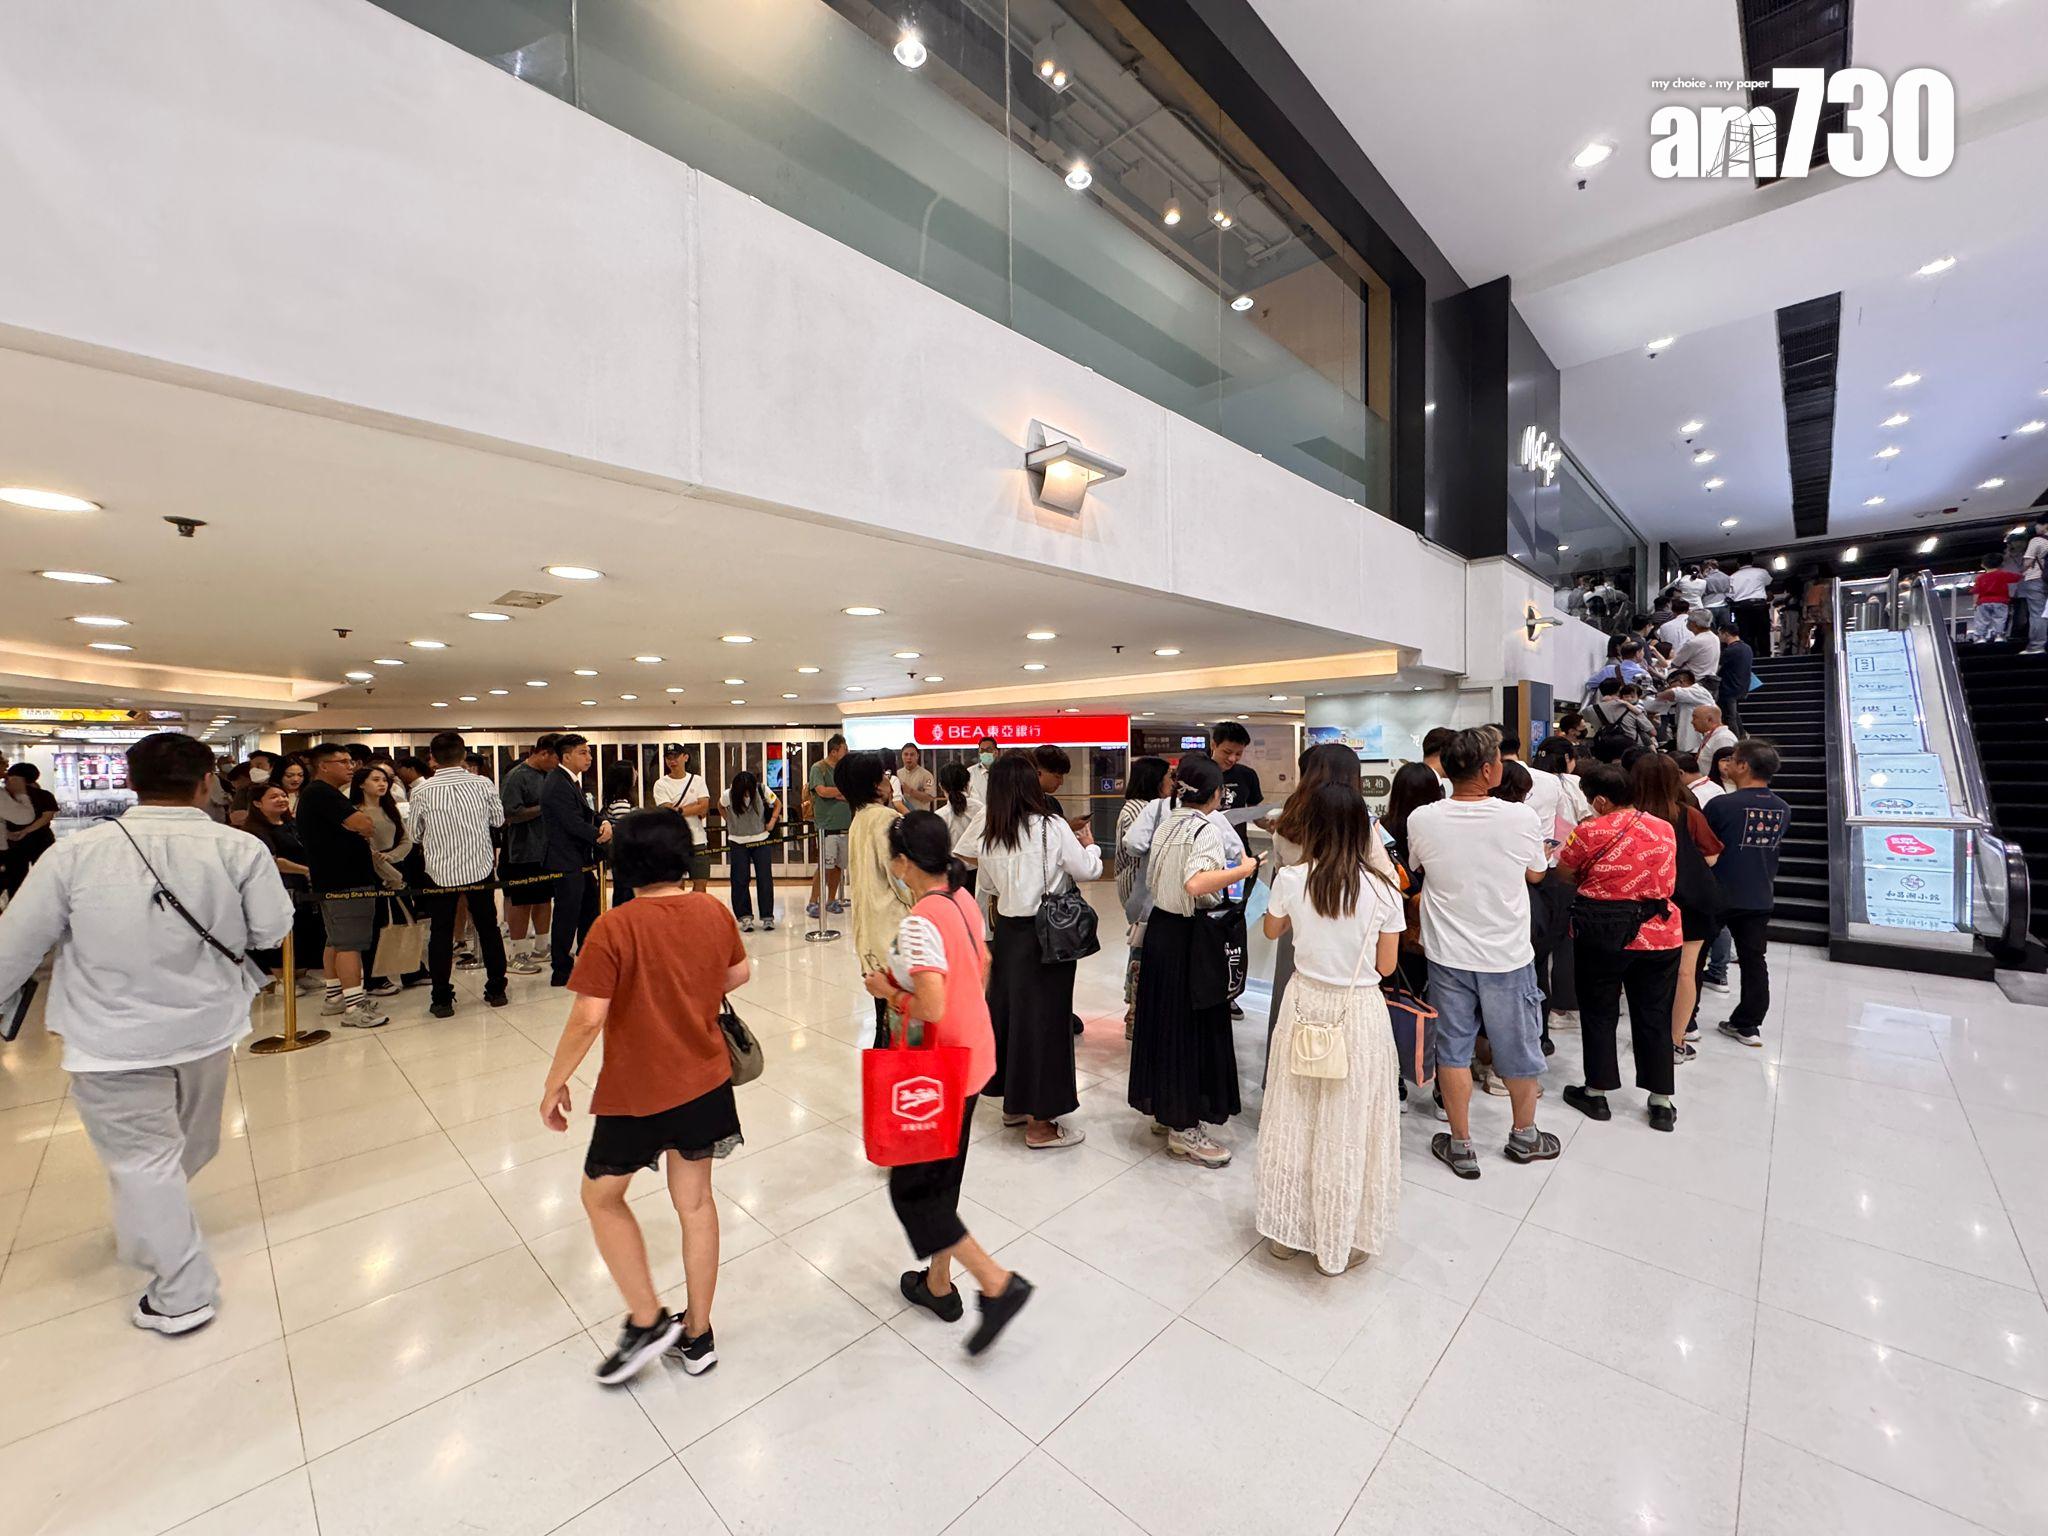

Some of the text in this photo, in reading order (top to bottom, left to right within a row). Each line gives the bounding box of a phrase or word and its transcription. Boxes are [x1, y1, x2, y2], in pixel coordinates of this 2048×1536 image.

[948, 724, 1041, 739] BEA 東亞銀行
[325, 891, 349, 900] Cheung
[350, 891, 364, 899] Sha
[364, 890, 377, 898] Wan
[422, 887, 444, 895] Cheung
